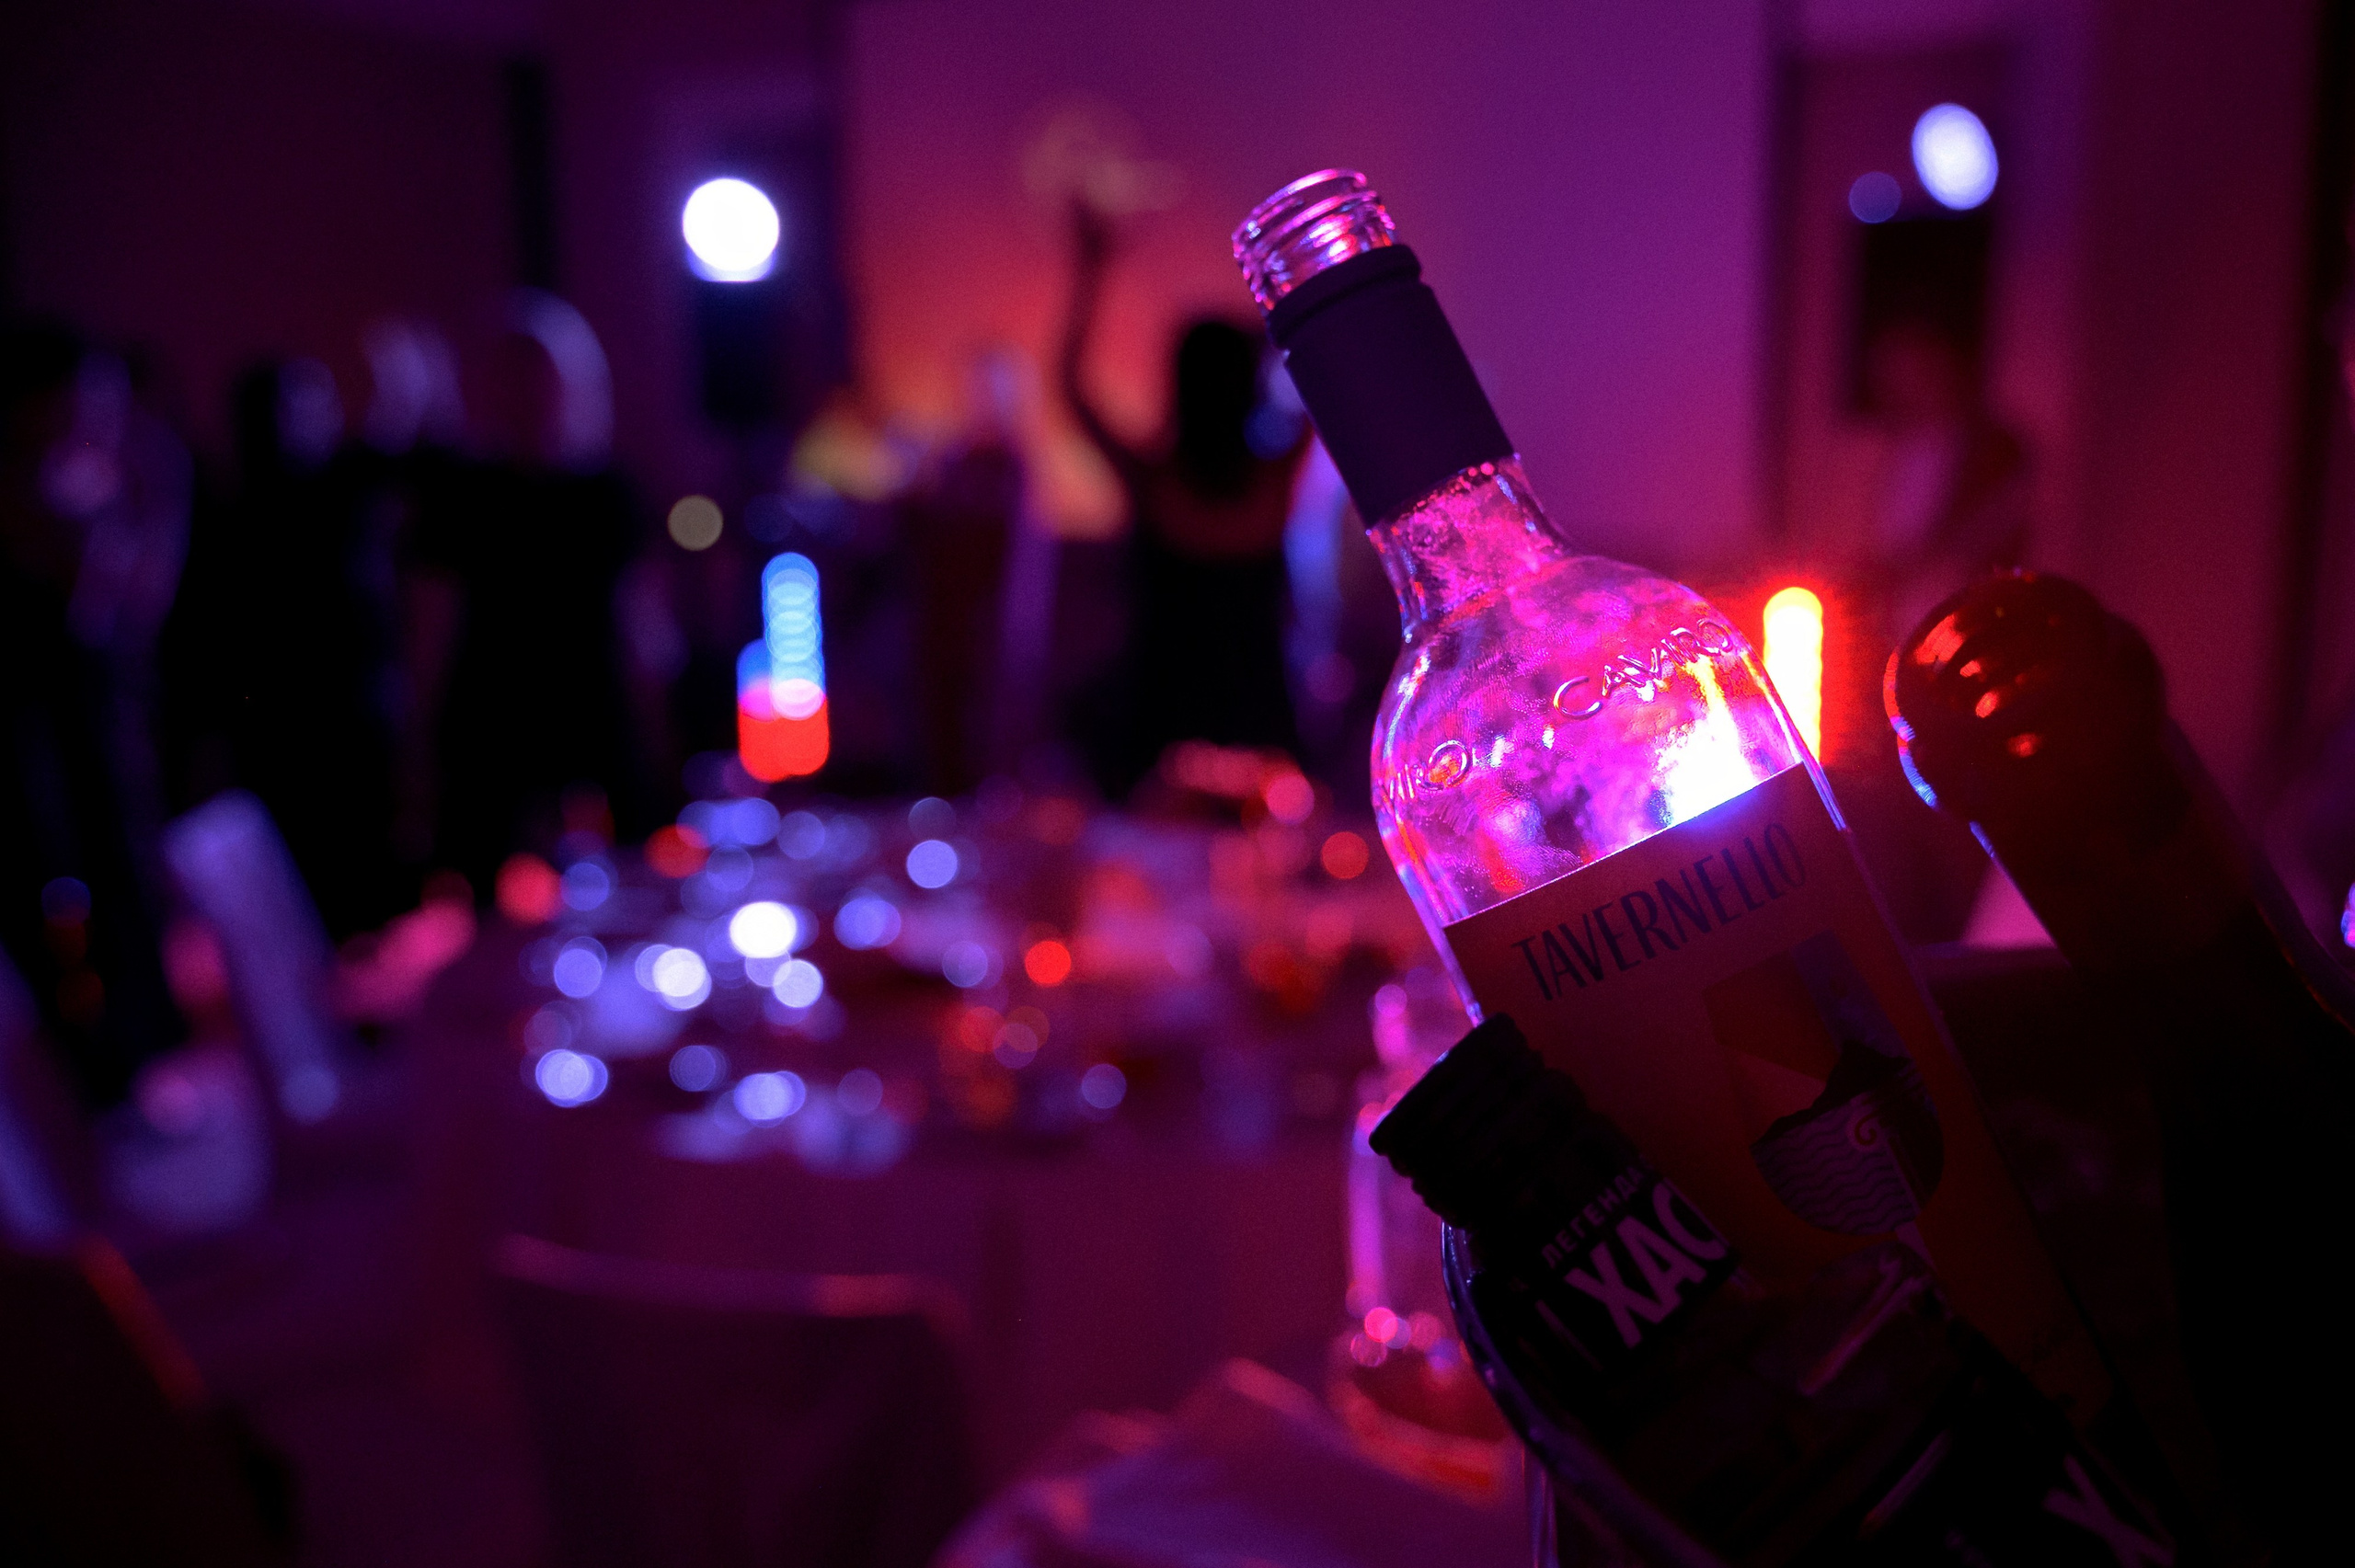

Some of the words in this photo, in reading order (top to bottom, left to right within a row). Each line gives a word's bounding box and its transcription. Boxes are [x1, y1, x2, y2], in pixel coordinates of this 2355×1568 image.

[1552, 617, 1734, 720] CAVIRO
[1511, 823, 1808, 1001] TAVERNELLO
[1563, 1176, 1731, 1352] ХАС
